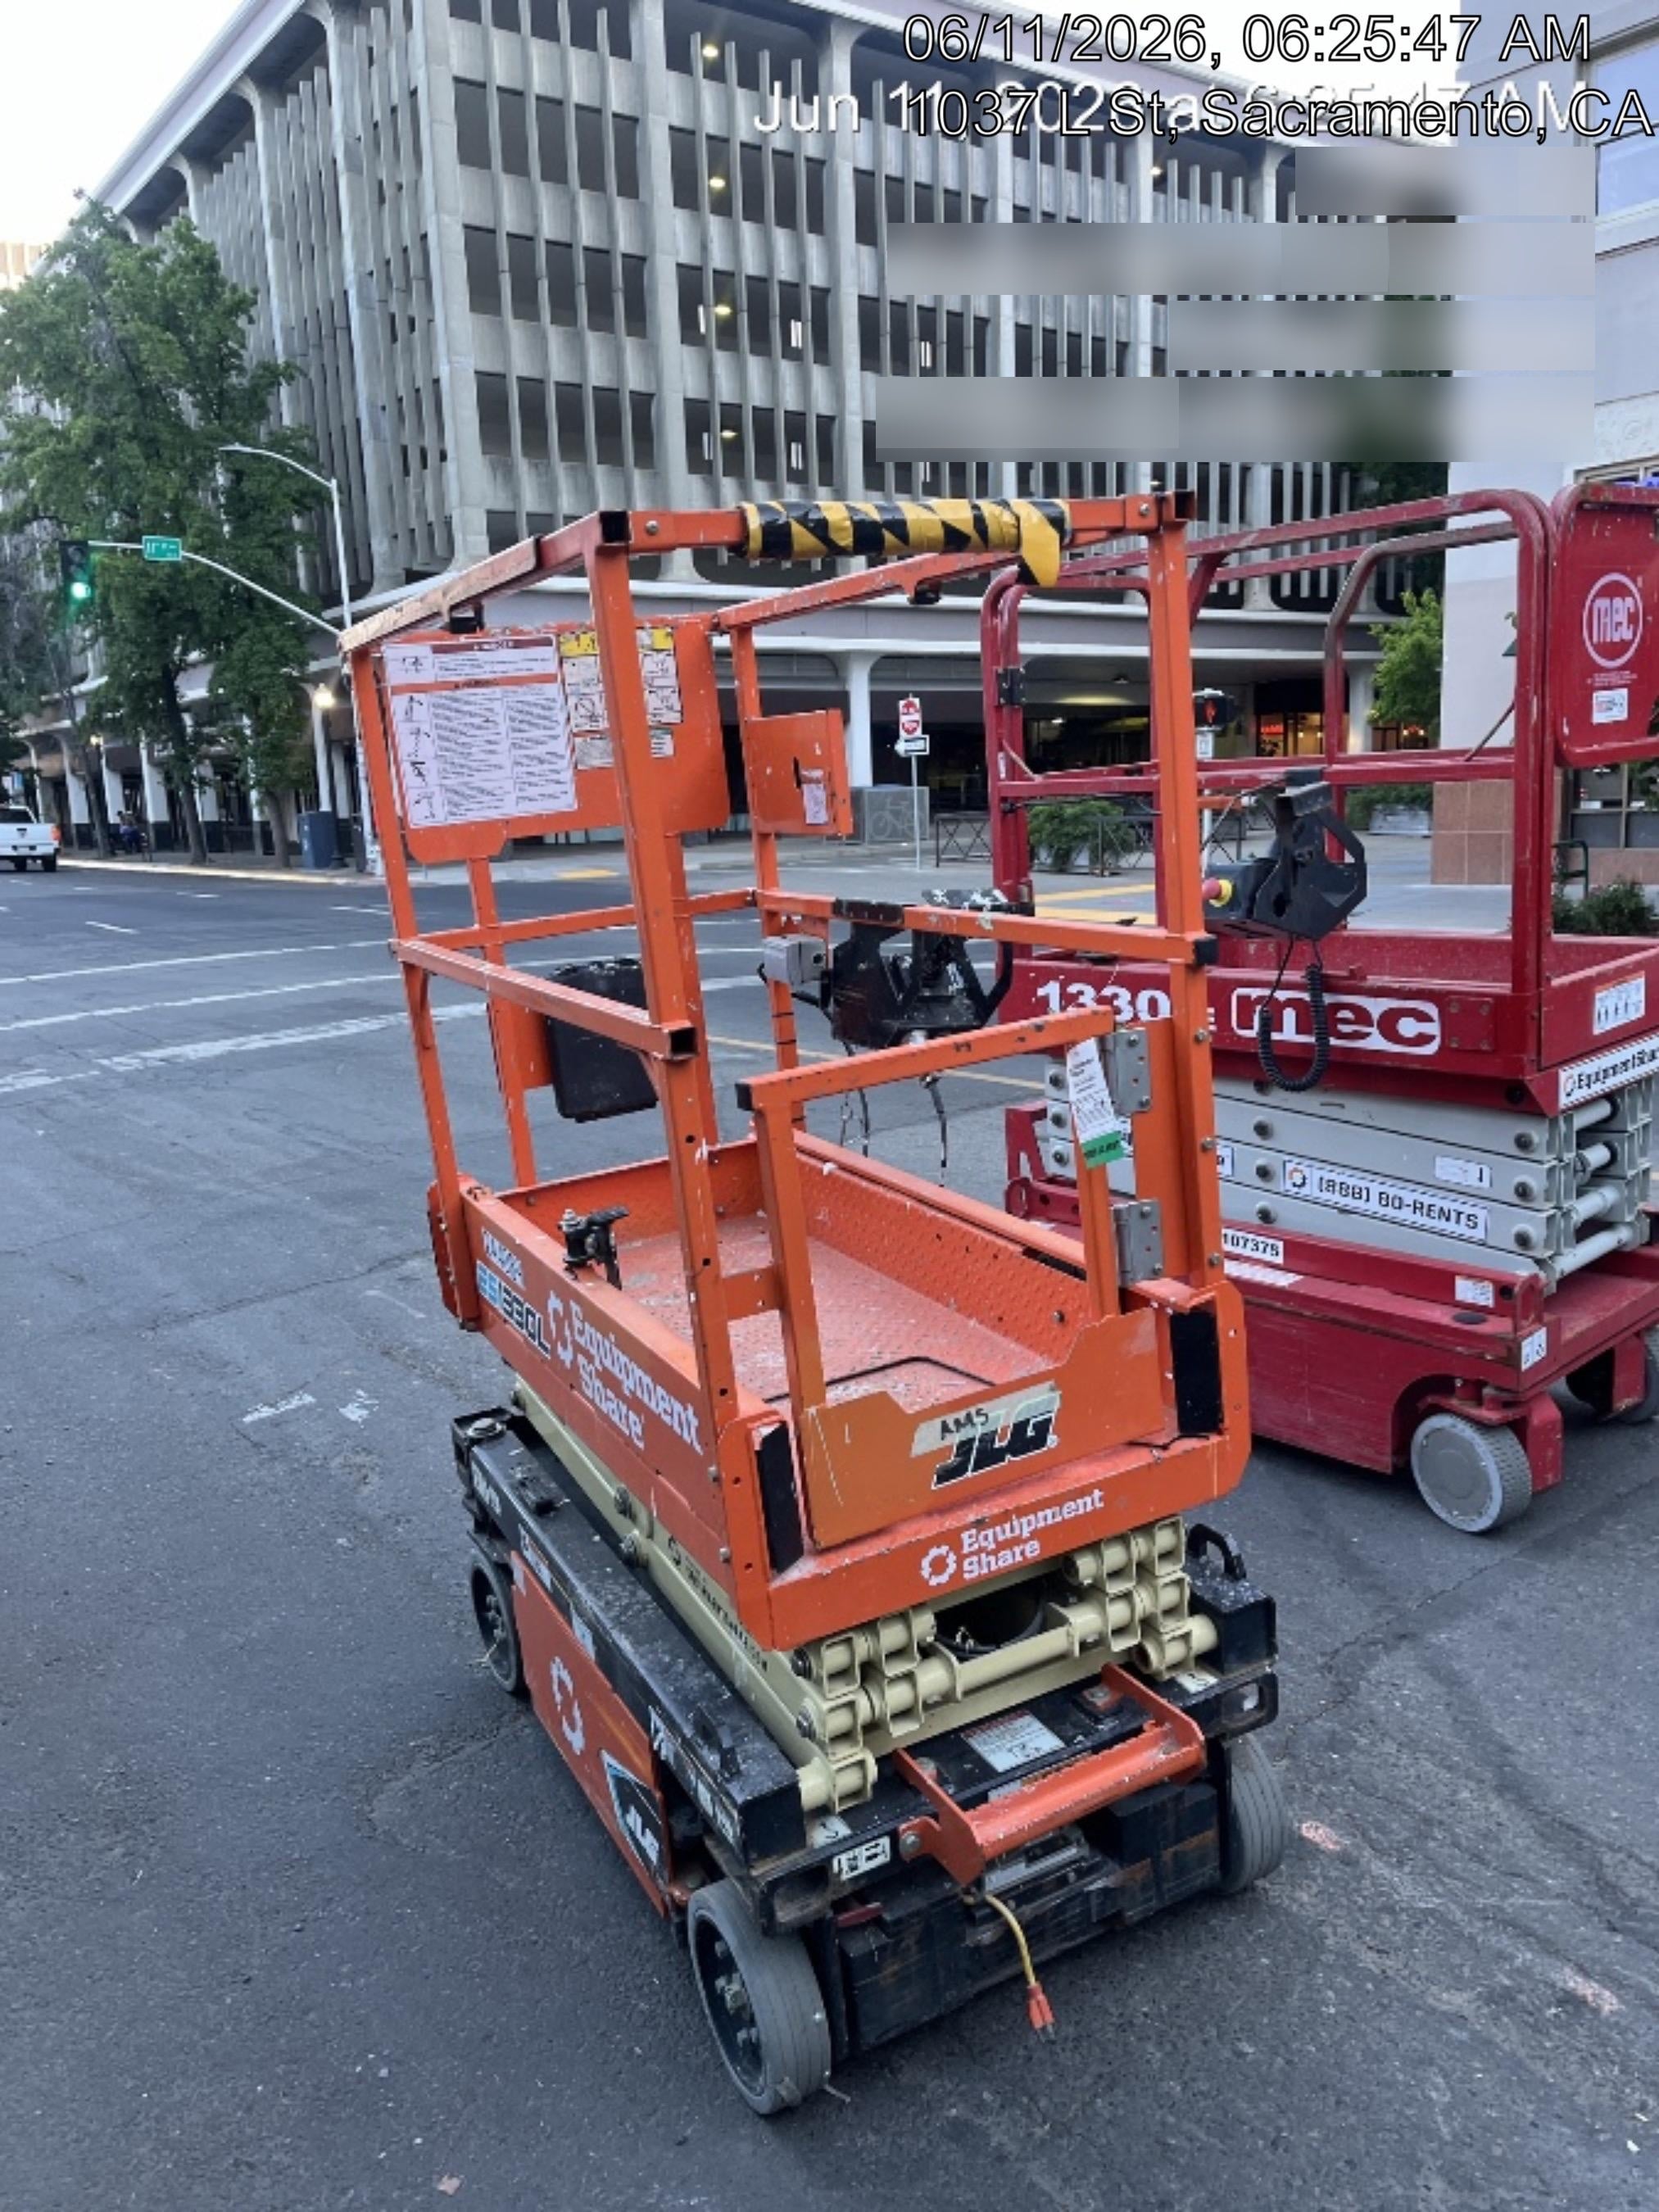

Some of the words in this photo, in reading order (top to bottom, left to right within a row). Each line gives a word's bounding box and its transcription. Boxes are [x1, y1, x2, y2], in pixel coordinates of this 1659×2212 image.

[1592, 596, 1636, 644] mec
[1036, 980, 1172, 1023] 1330
[1235, 991, 1437, 1049] mec
[1377, 1193, 1479, 1230] 80-RENTS
[569, 1299, 705, 1456] Equipment
[577, 1353, 646, 1451] Share
[931, 1392, 1062, 1490] JLG
[960, 1488, 1105, 1554] Equipment
[962, 1539, 1041, 1581] Share
